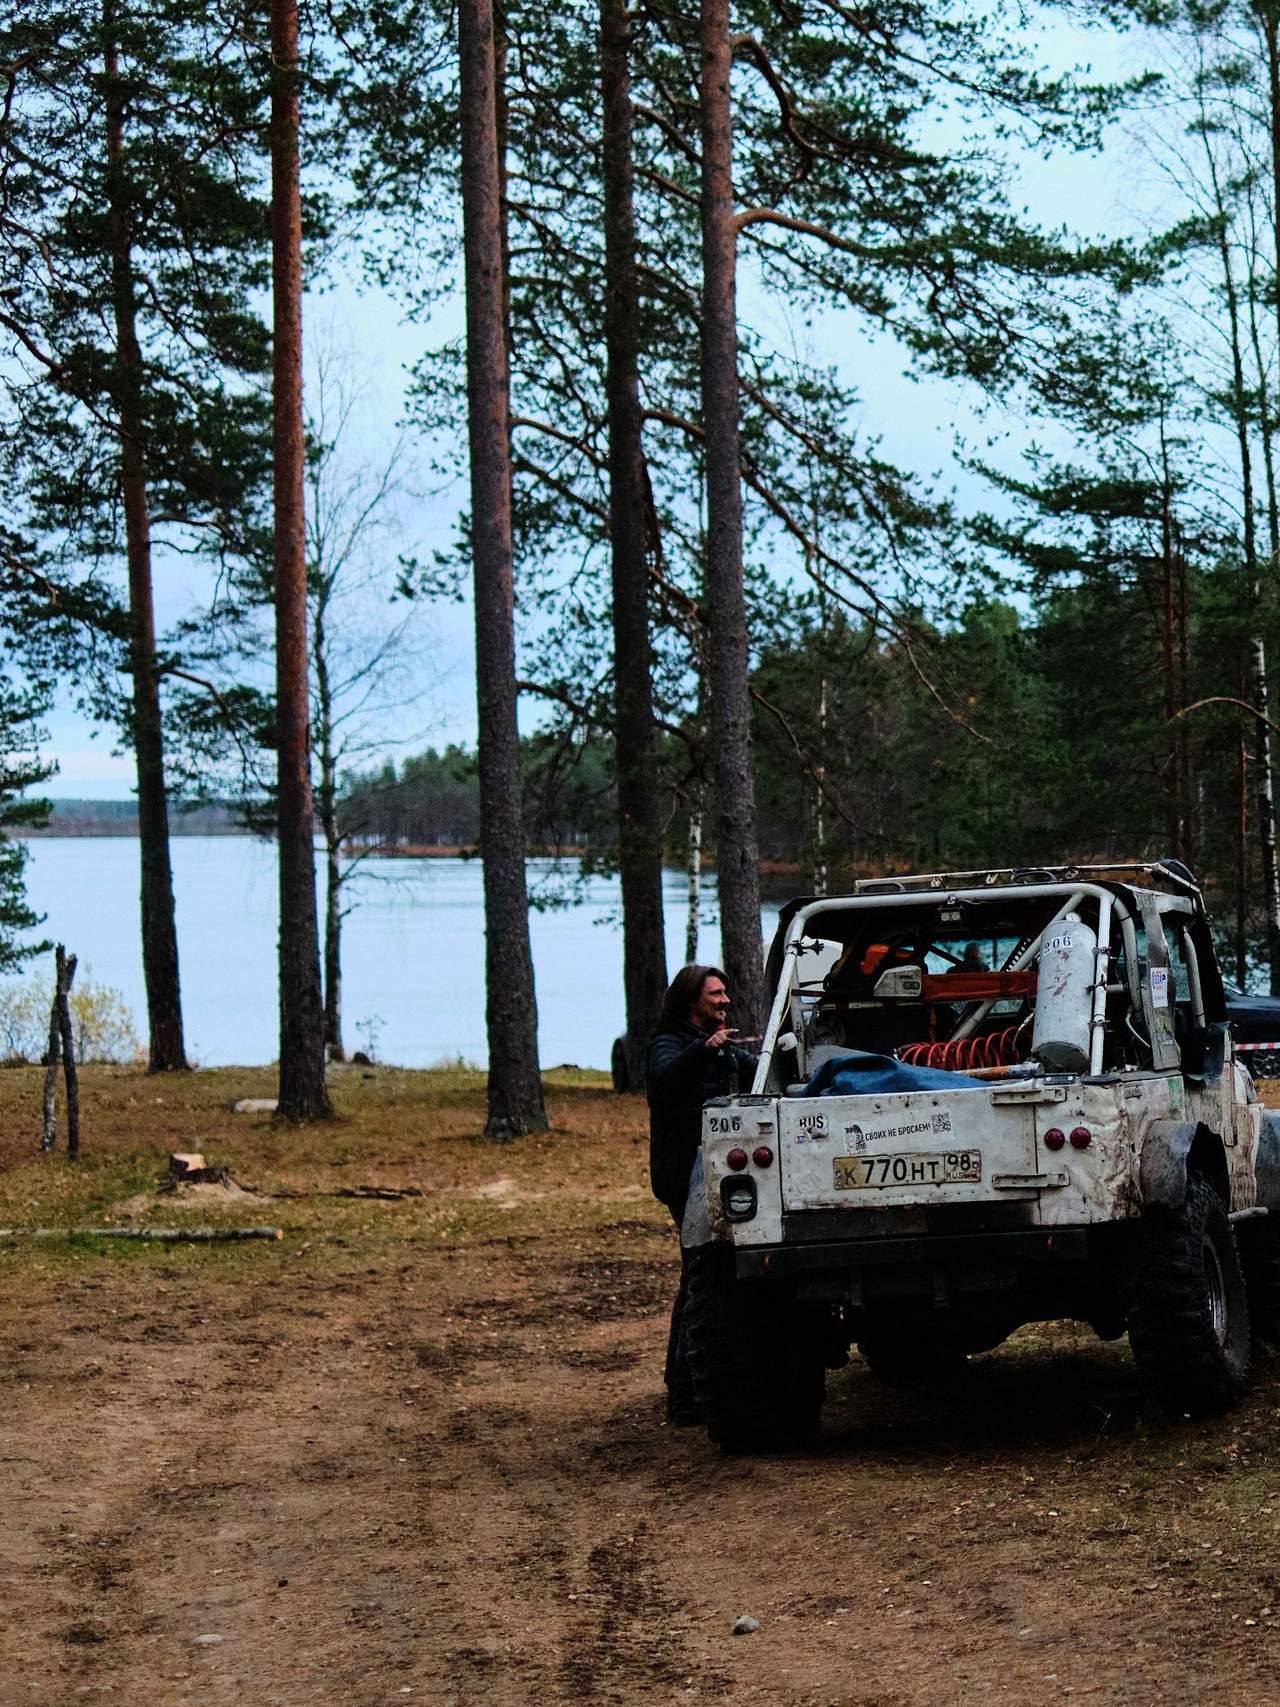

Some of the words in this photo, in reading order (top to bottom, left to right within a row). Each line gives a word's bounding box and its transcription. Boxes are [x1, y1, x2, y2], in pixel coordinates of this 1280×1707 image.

[1044, 936, 1071, 954] 206
[710, 1117, 740, 1132] 206
[865, 1130, 886, 1141] СВОИХ
[888, 1128, 898, 1137] НЕ
[898, 1124, 931, 1136] БРОСАЕМ!
